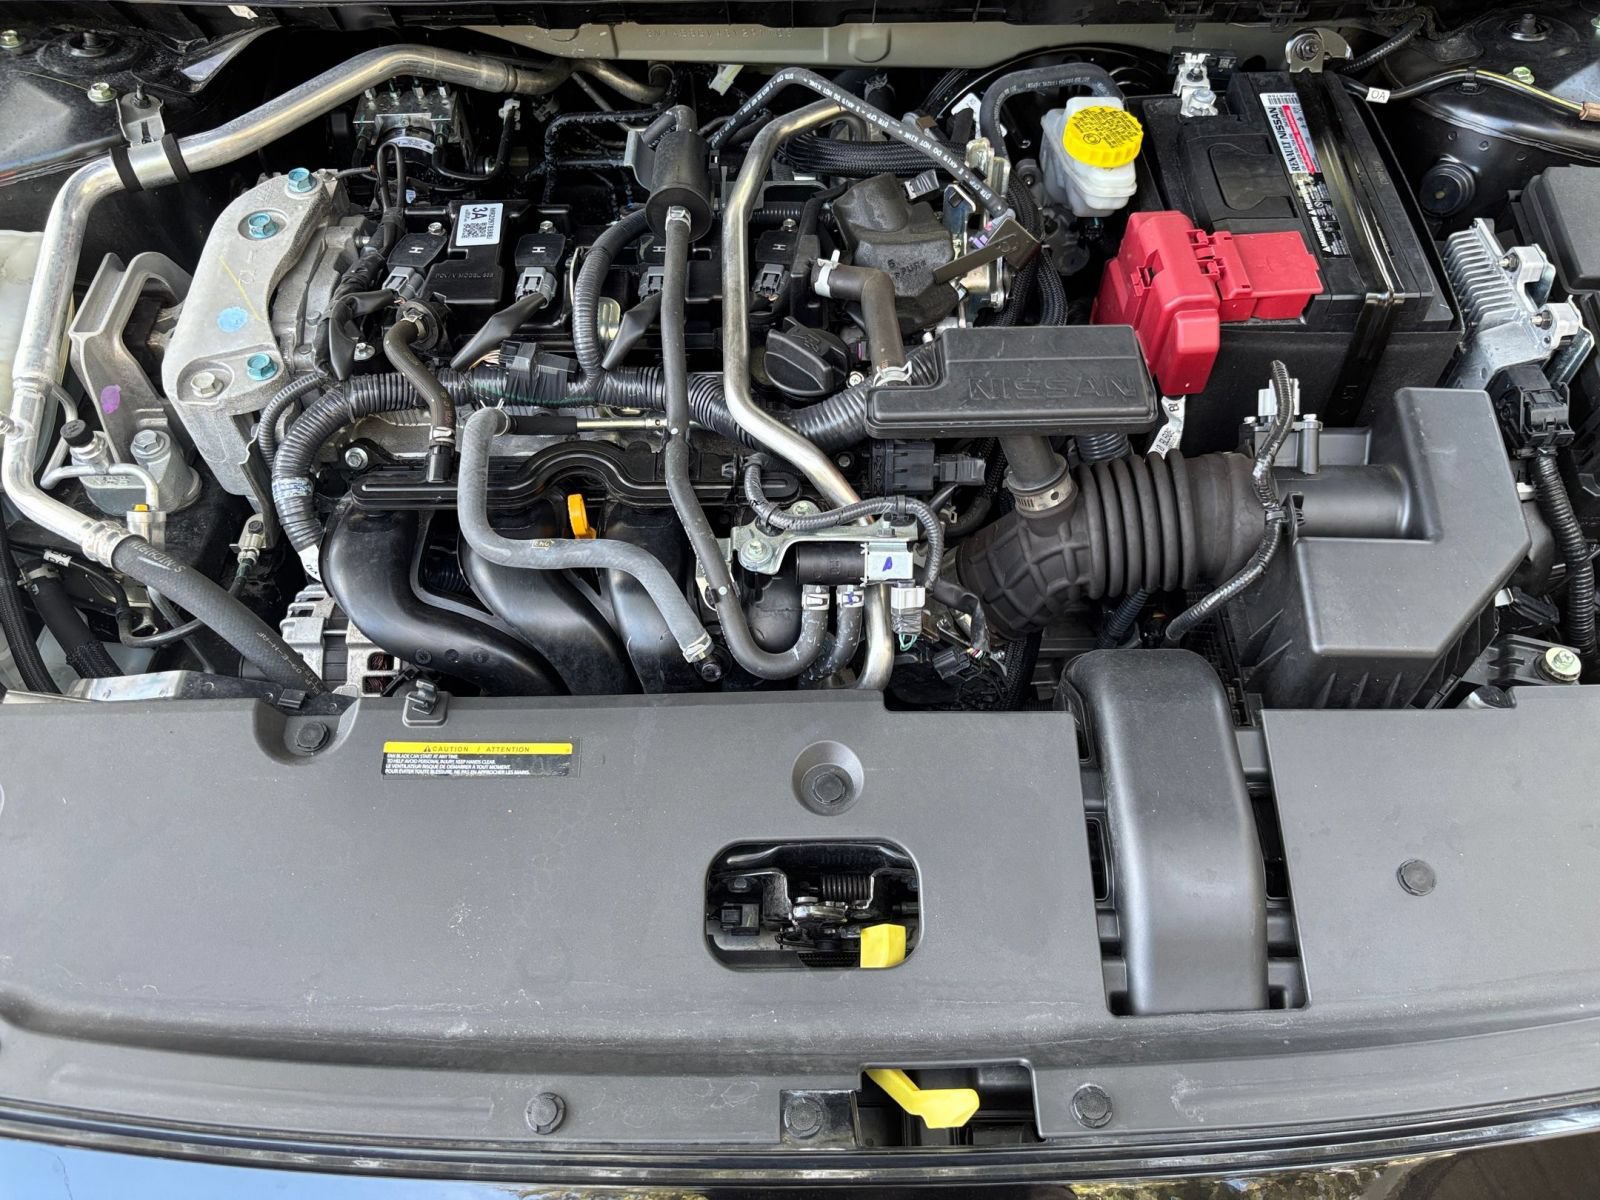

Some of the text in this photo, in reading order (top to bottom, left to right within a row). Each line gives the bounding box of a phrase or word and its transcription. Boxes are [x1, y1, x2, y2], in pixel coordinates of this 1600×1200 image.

[1268, 107, 1288, 140] NISSAN
[1281, 141, 1301, 172] RENAULT
[471, 207, 488, 220] 3A
[967, 375, 1137, 400] NISSAN
